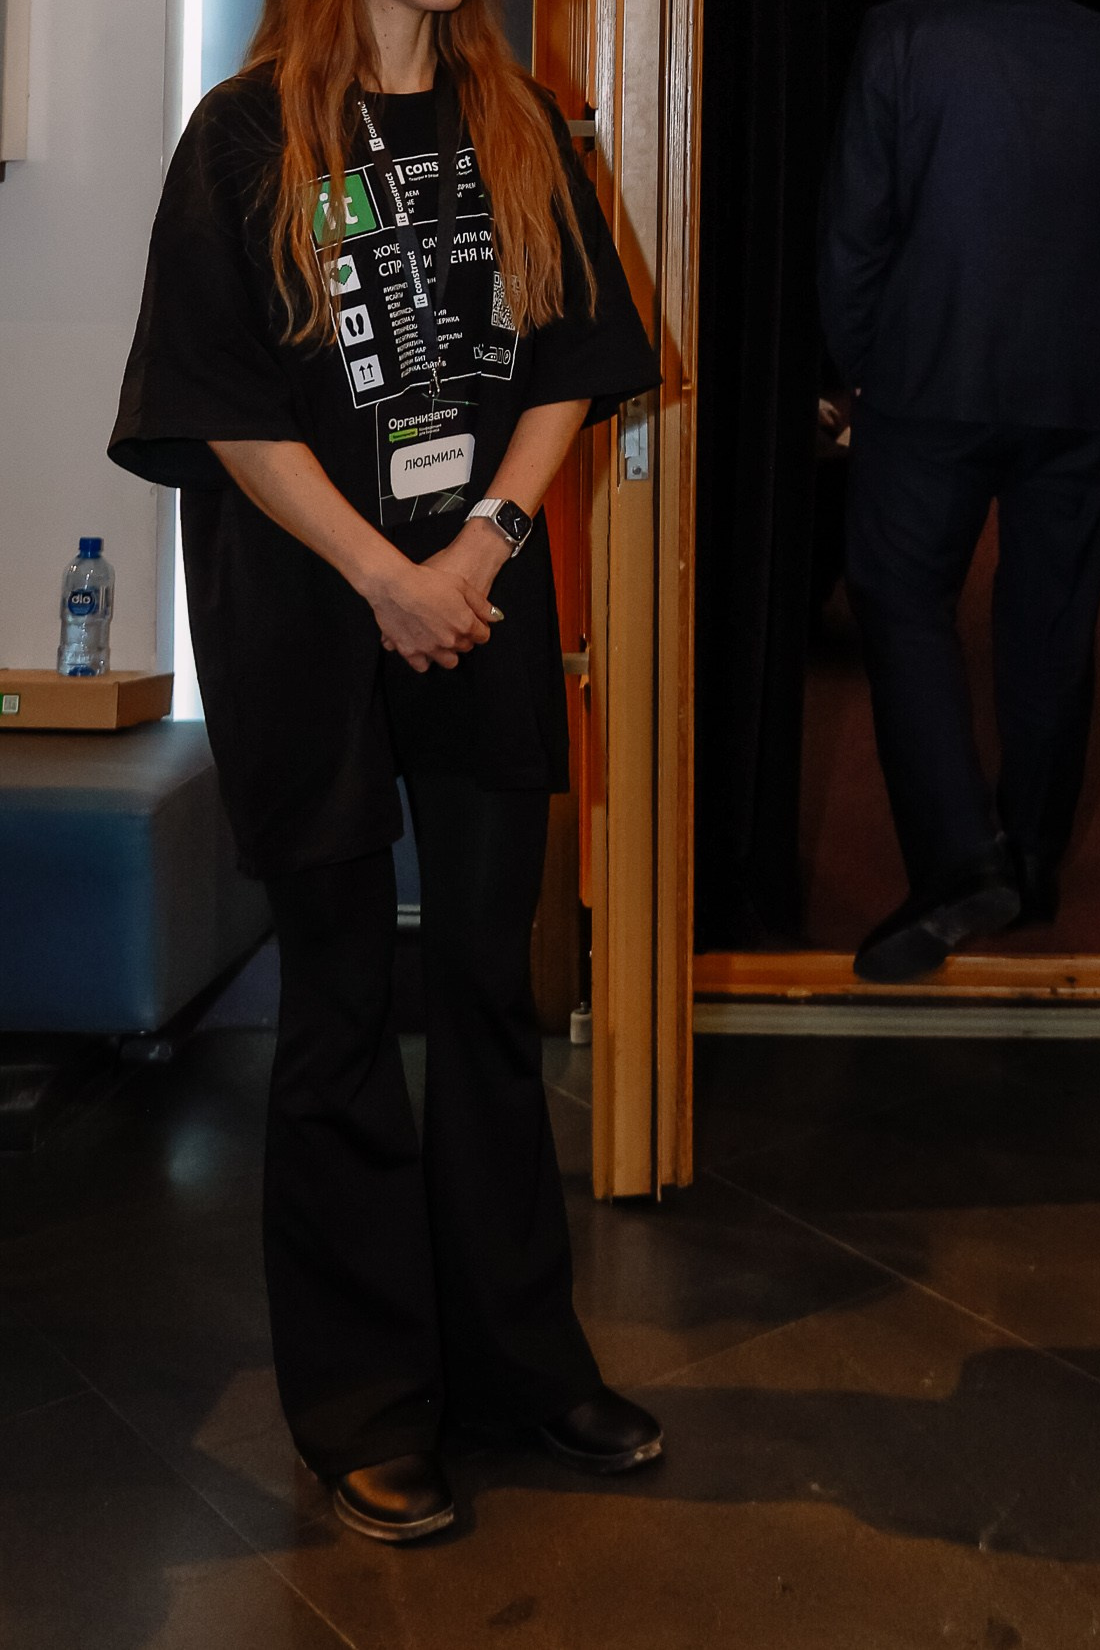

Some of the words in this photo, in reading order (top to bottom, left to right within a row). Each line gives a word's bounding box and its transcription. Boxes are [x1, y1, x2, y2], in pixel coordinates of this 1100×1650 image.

[405, 155, 472, 176] consct
[385, 172, 404, 212] construct
[453, 232, 478, 245] ИЛИ
[450, 248, 478, 264] ЕНЯ
[406, 250, 422, 293] construct
[388, 408, 458, 431] Организатор
[404, 448, 464, 471] ЛЮДМИЛА
